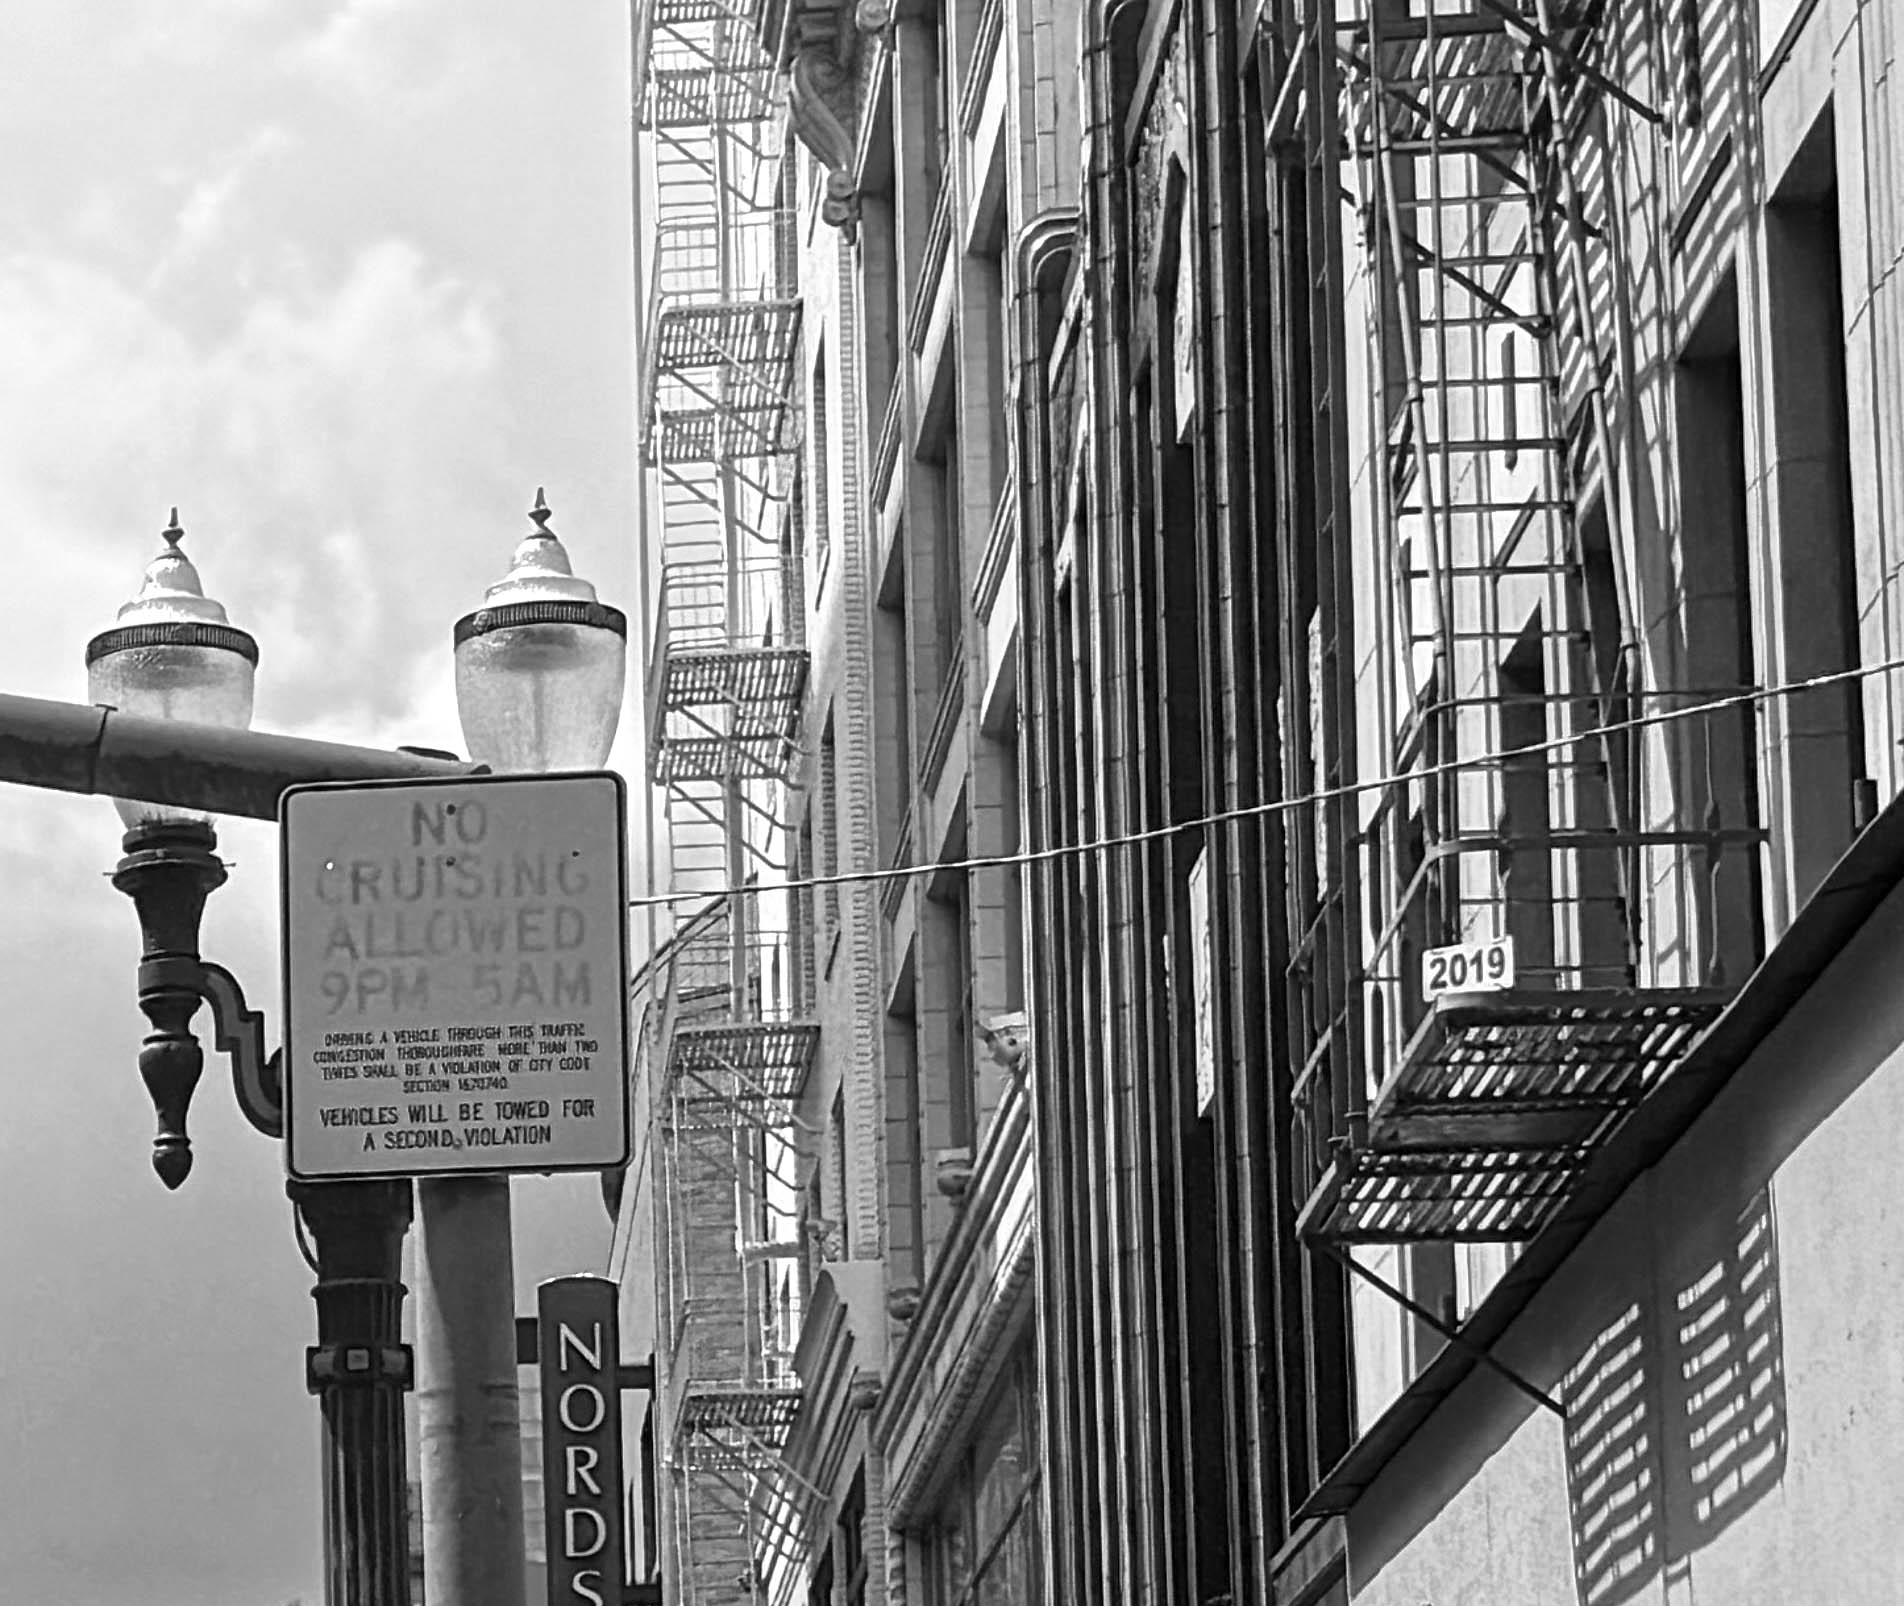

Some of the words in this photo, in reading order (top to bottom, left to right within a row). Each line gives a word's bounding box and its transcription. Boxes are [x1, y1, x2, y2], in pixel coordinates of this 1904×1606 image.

[411, 799, 488, 847] NO
[315, 850, 591, 906] CRUISING
[322, 903, 586, 962] ALLOWED
[1429, 946, 1506, 990] 2019
[393, 1028, 440, 1044] VEHICLE
[447, 1026, 501, 1042] THROUGH
[312, 1048, 386, 1065] CONGESTION
[537, 1039, 567, 1055] THAN
[362, 1063, 398, 1079] SHALL
[405, 1062, 422, 1077] BE
[428, 1062, 437, 1076] A
[442, 1060, 501, 1075] VIOLATION
[528, 1058, 554, 1072] CITY
[402, 1079, 450, 1094] SECTION
[319, 1106, 399, 1128] VEHICLES
[407, 1103, 449, 1124] WILL
[458, 1102, 485, 1122] BE
[495, 1100, 550, 1121] TOWED
[562, 1098, 595, 1119] FOR
[362, 1131, 376, 1152] A
[383, 1128, 454, 1150] SECOND
[463, 1124, 552, 1147] VIOLATION
